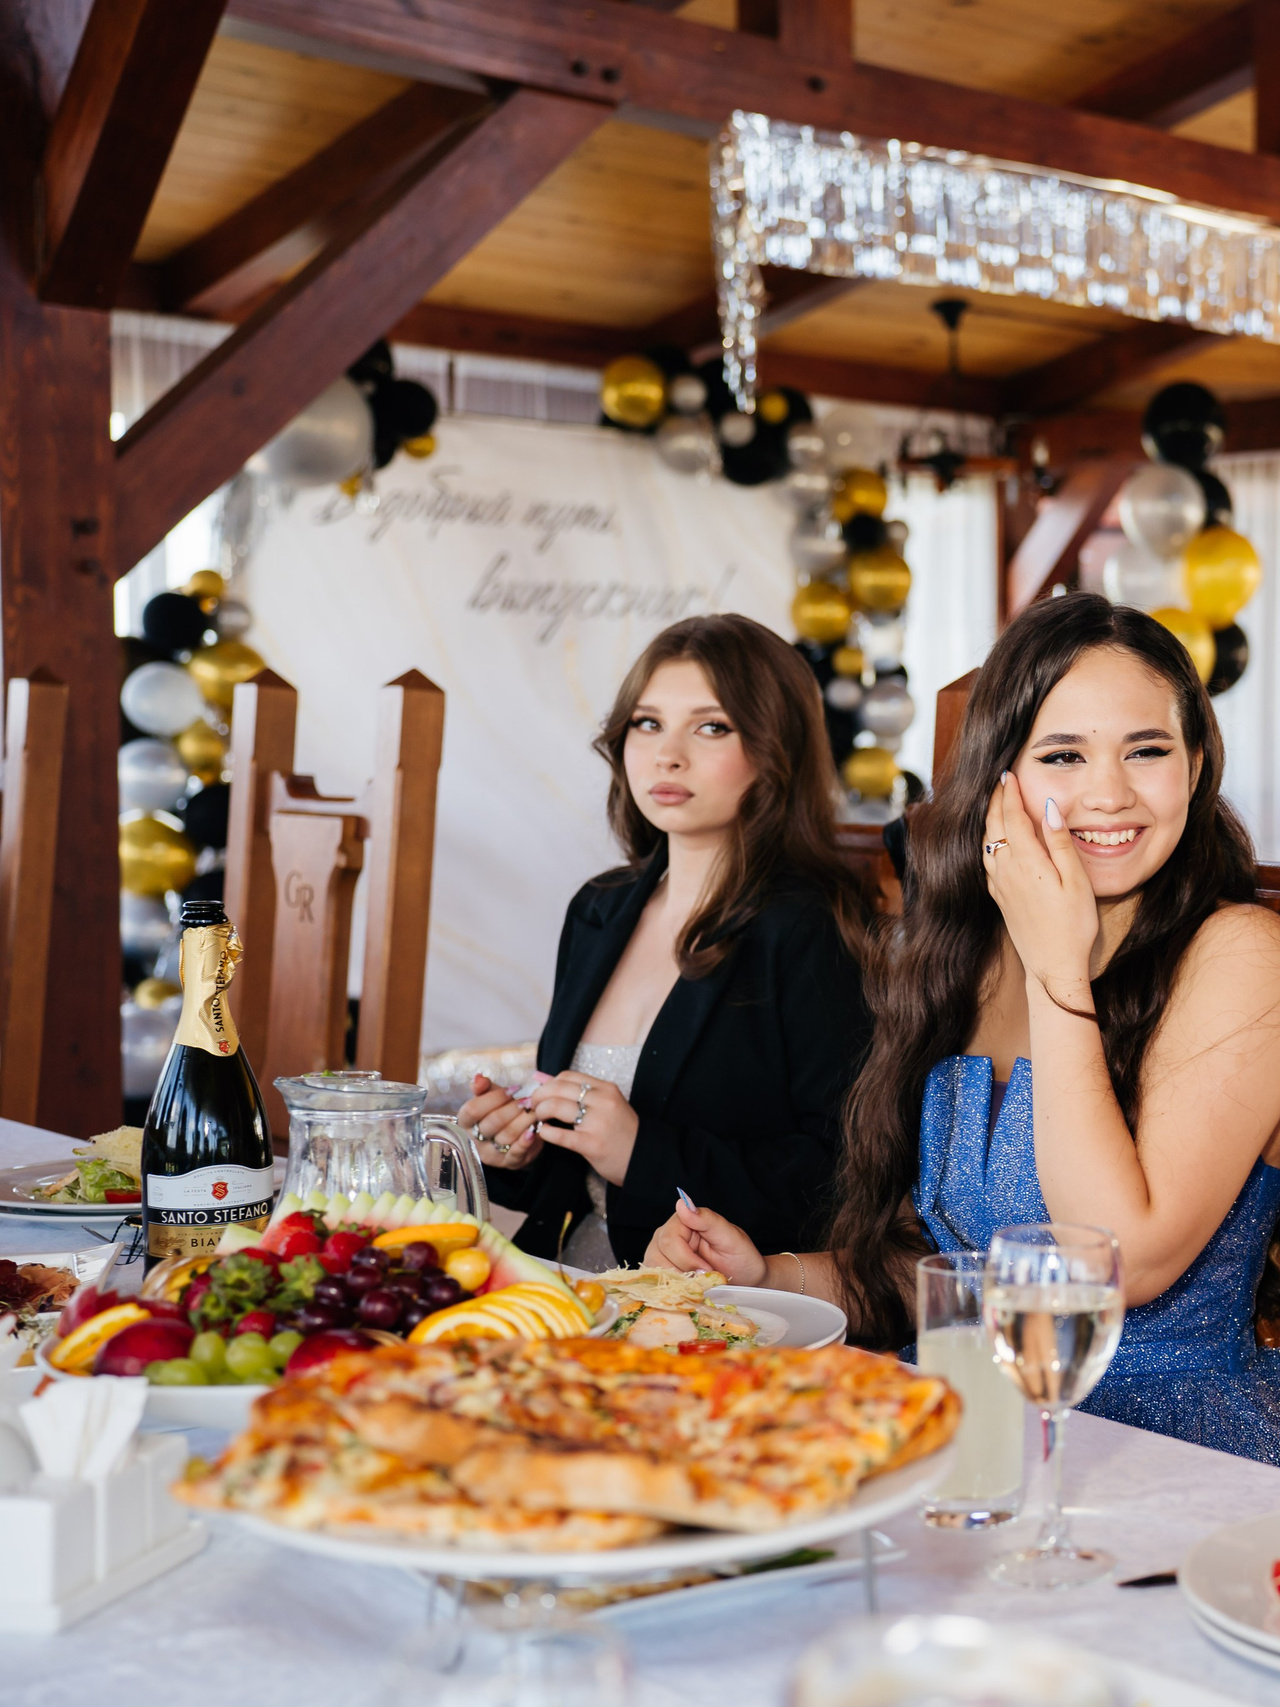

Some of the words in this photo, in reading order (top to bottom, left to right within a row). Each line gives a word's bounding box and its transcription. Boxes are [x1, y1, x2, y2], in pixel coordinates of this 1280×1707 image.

[211, 997, 226, 1034] SANTO
[160, 1211, 208, 1224] SANTO
[213, 1202, 269, 1223] STEFANO
